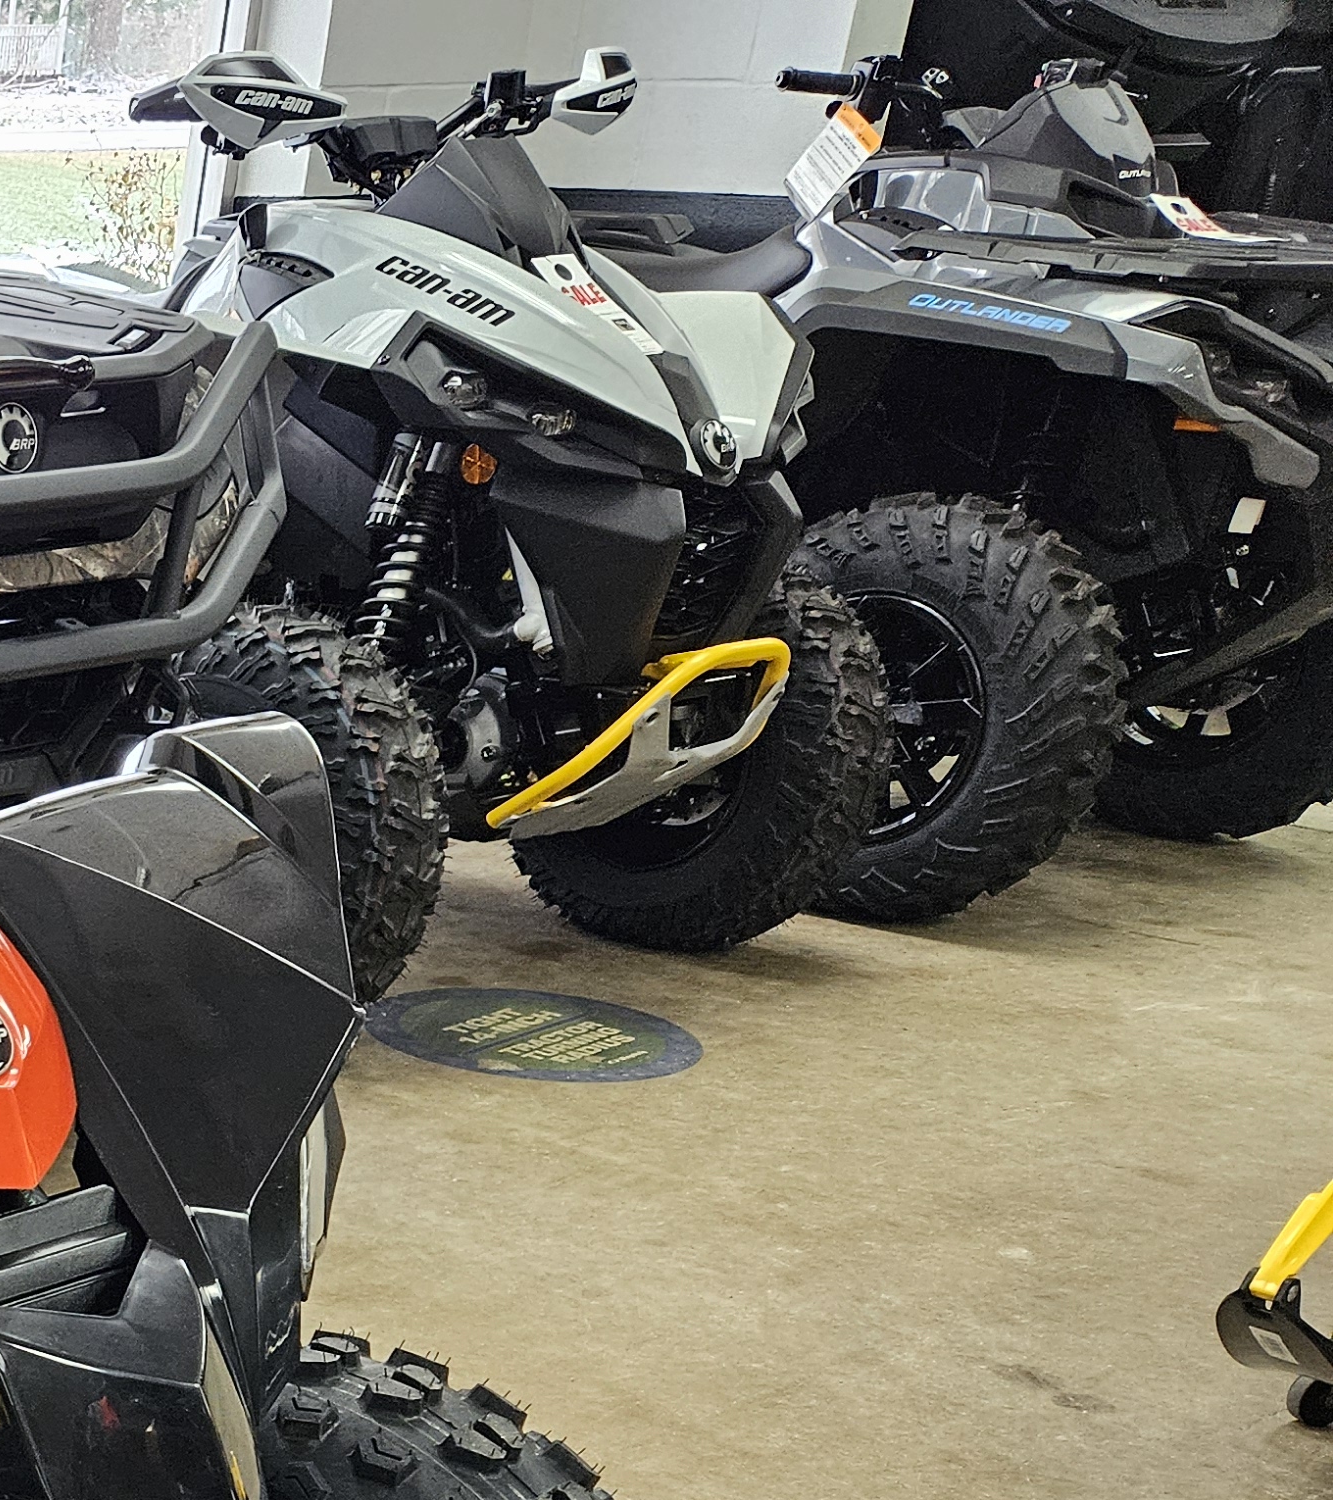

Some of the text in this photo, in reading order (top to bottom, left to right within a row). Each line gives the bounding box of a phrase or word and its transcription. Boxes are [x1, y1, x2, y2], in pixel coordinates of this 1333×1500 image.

[234, 89, 314, 115] can-am
[375, 256, 516, 327] can-am
[908, 293, 1072, 333] OUTLANDER
[9, 438, 35, 451] BRP
[442, 1007, 522, 1034] TIGHT
[458, 1010, 564, 1045] 14-INCH
[498, 1020, 605, 1056] TRACTOR
[520, 1027, 623, 1061] TURNING
[549, 1035, 636, 1064] RADIUS
